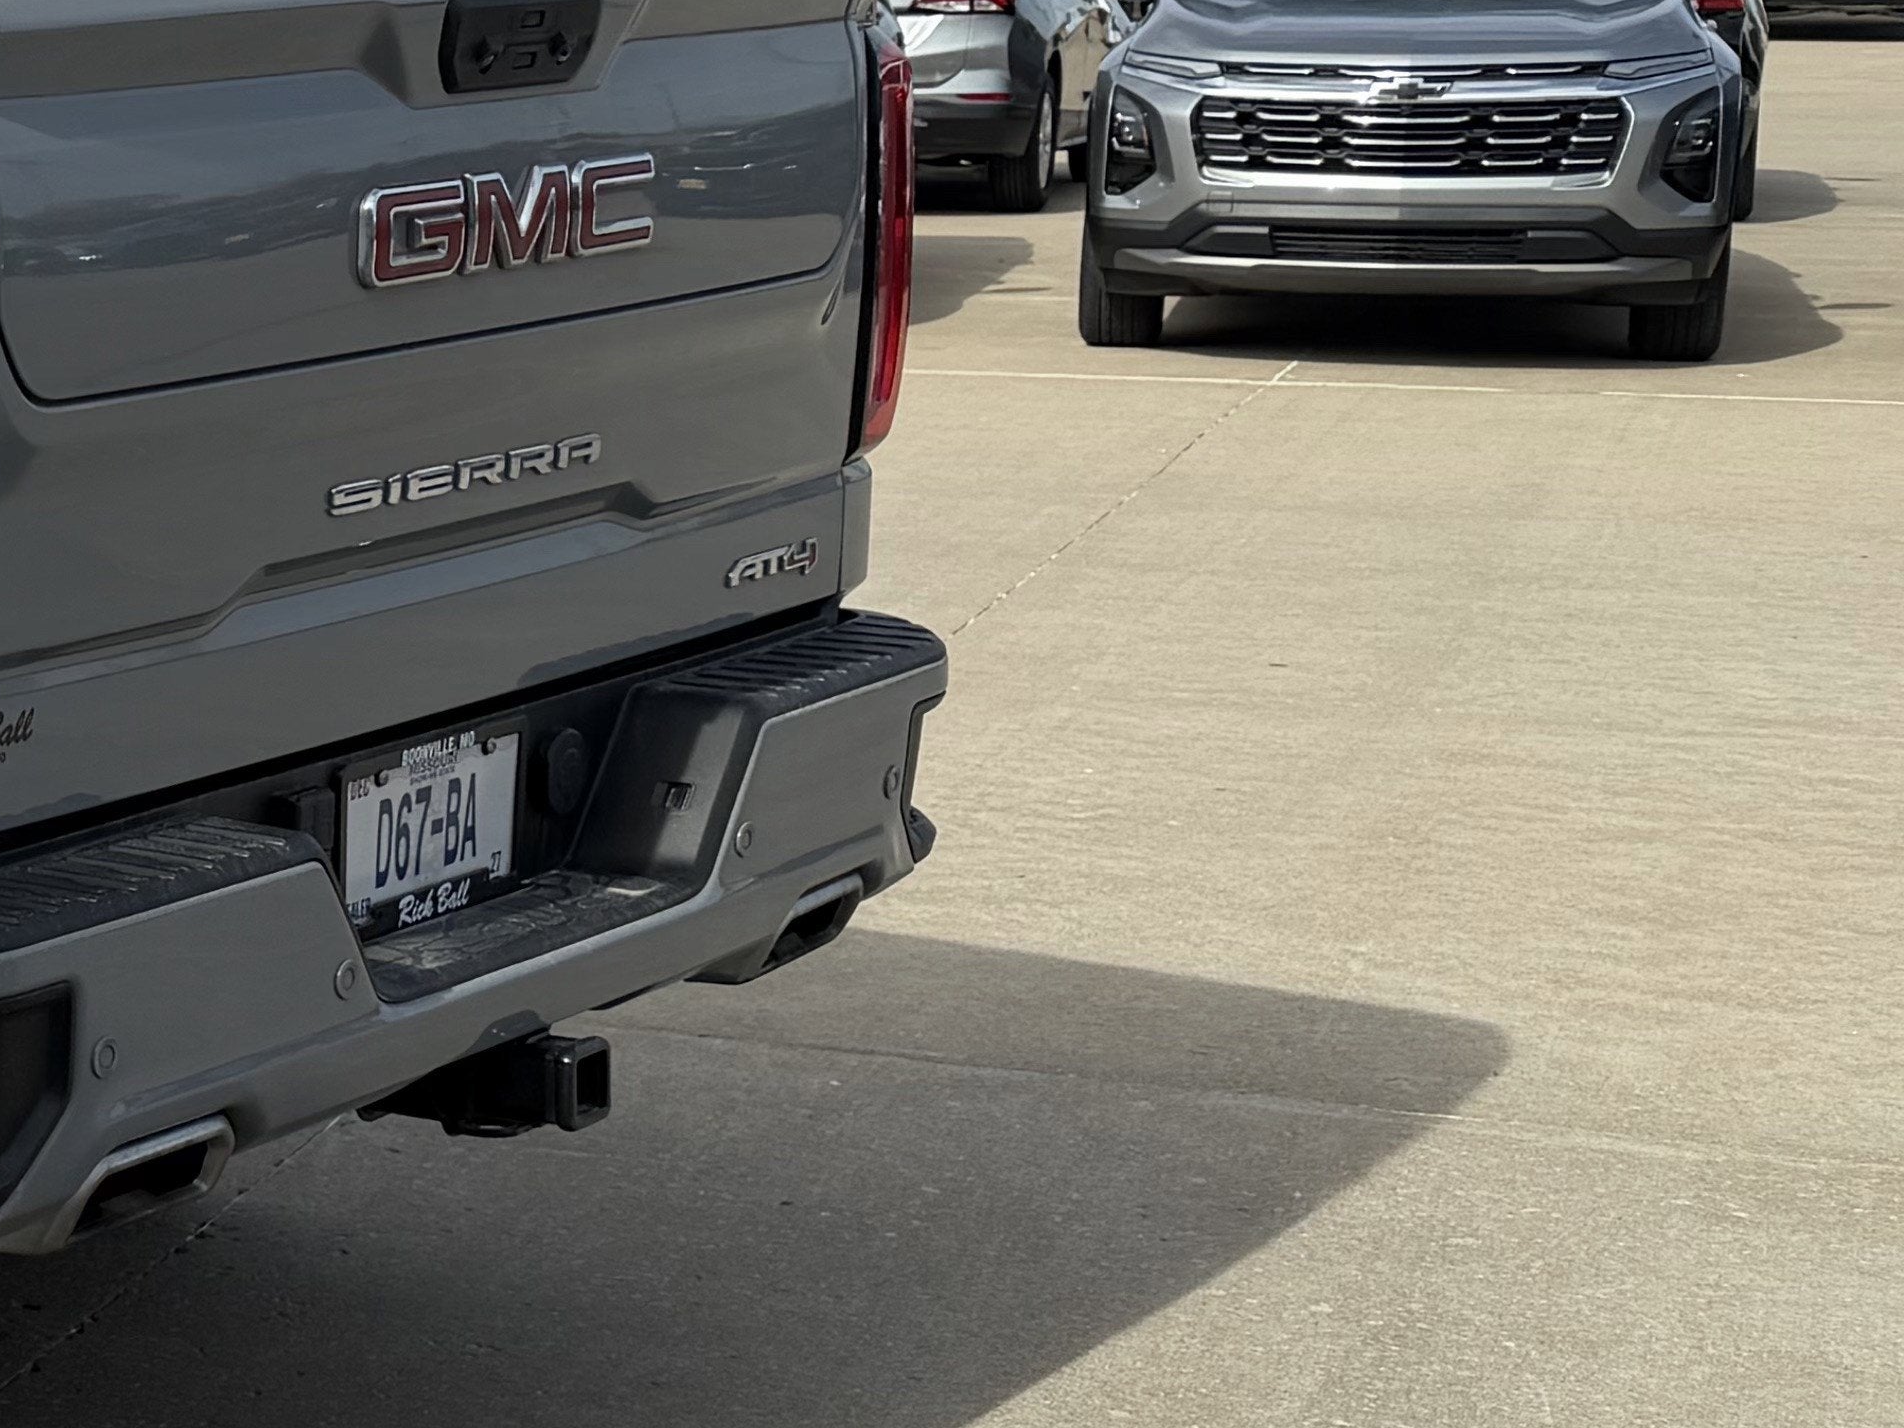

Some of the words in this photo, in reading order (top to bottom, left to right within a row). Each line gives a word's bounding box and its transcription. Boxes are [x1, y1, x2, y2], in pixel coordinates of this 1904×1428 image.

[354, 152, 655, 289] GMC
[326, 433, 602, 517] SIERRA
[724, 537, 818, 589] AT4
[460, 730, 475, 748] MO
[375, 773, 476, 889] D67-BA
[398, 888, 433, 928] Rick
[436, 877, 471, 915] Ball
